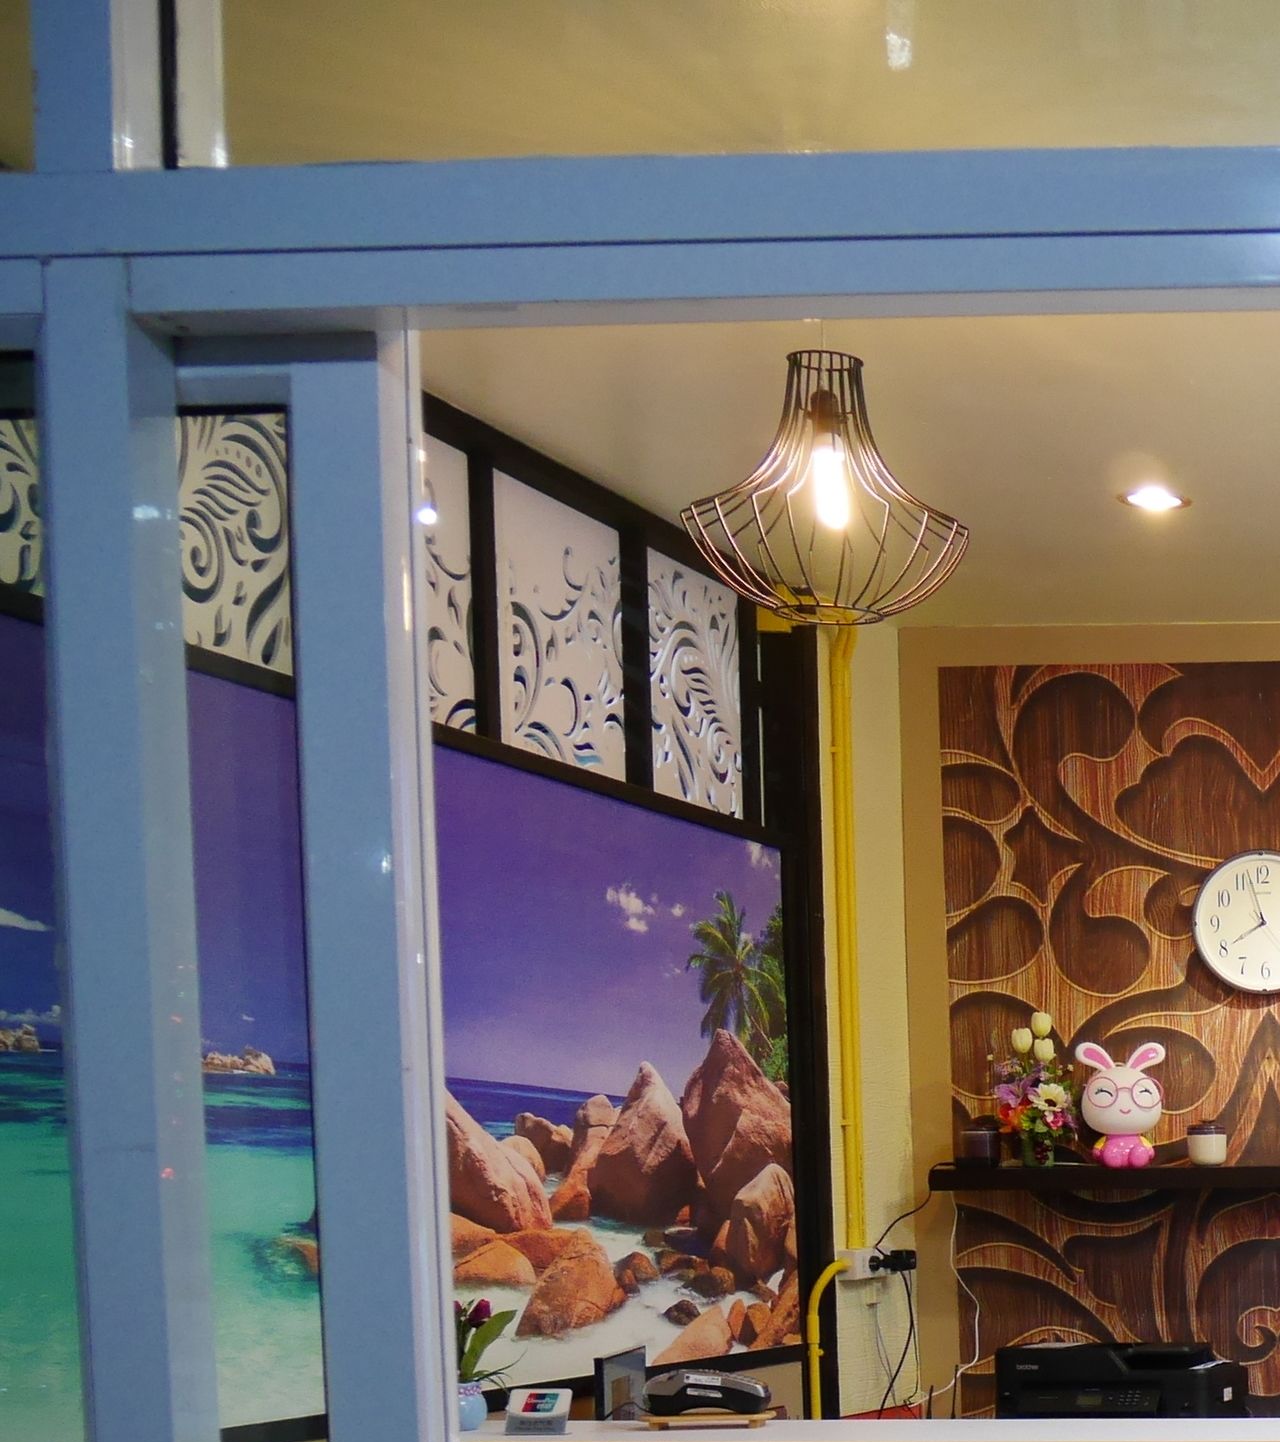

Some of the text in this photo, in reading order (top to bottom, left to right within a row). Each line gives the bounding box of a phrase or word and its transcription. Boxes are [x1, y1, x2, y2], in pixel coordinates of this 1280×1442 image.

[1235, 872, 1245, 891] 11
[1256, 864, 1270, 884] 12
[1217, 888, 1231, 908] 10
[1209, 913, 1220, 934] 9
[1219, 939, 1229, 958] 8
[1238, 956, 1247, 975] 7
[1260, 961, 1271, 980] 6
